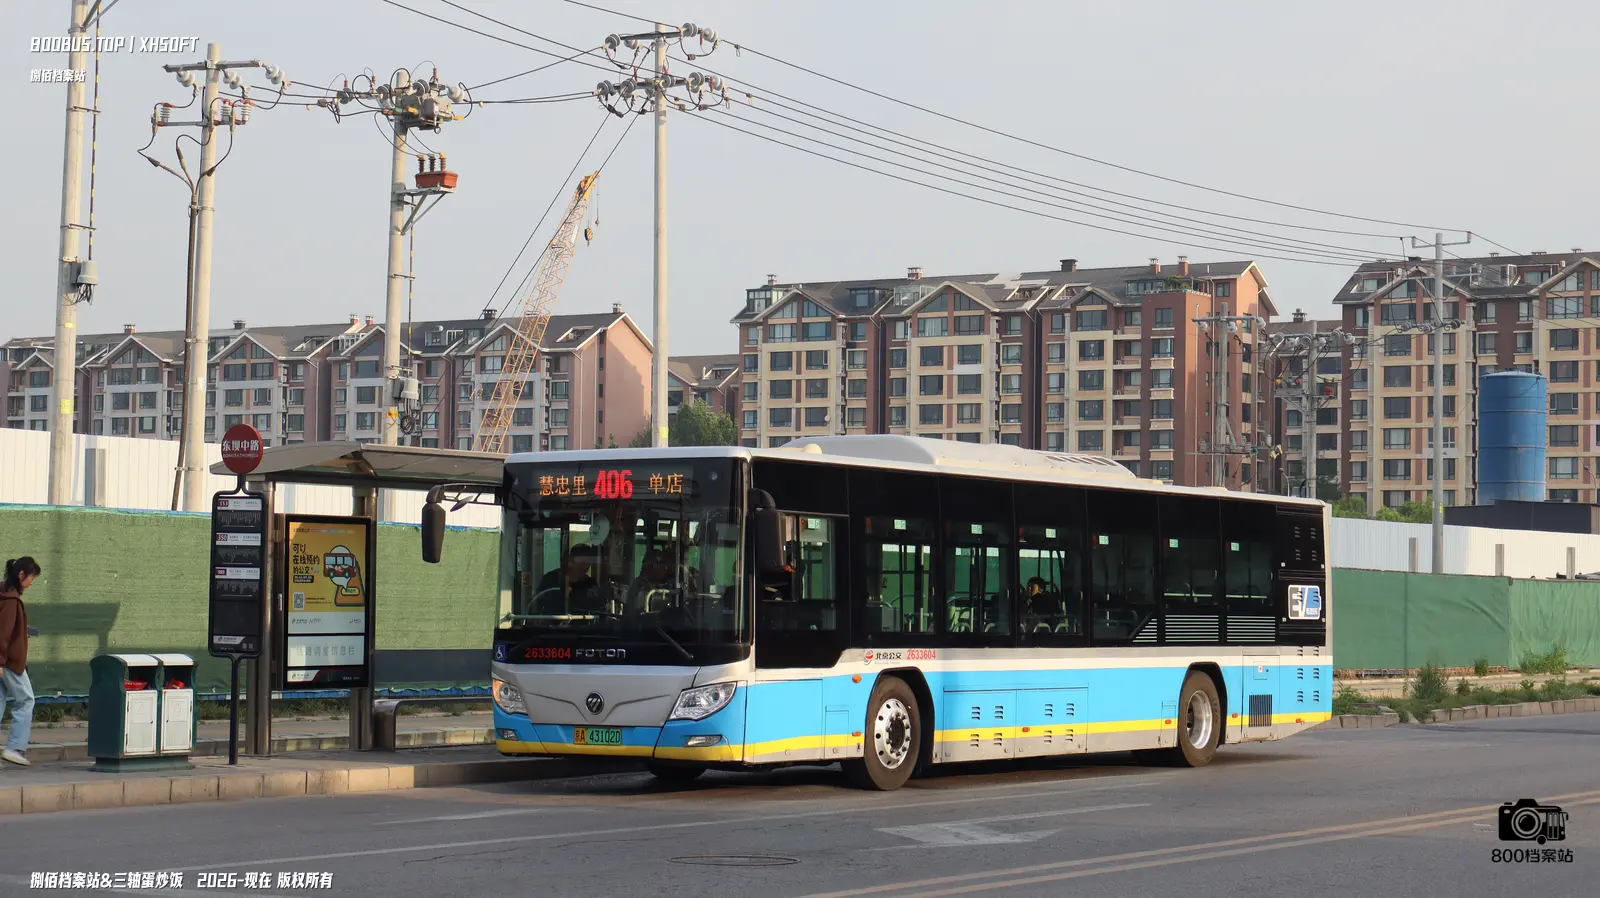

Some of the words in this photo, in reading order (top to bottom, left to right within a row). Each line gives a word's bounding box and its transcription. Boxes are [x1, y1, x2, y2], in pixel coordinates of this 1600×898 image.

[222, 440, 260, 452] 东坝中路
[538, 475, 587, 496] 慧忠里
[593, 469, 633, 499] 406
[647, 472, 684, 495] 单店
[292, 543, 306, 554] 可以
[292, 554, 320, 565] 在线预约
[524, 647, 571, 659] 2633604
[575, 648, 626, 659] FOTON
[906, 649, 936, 660] 2633604
[589, 729, 621, 743] 43102D
